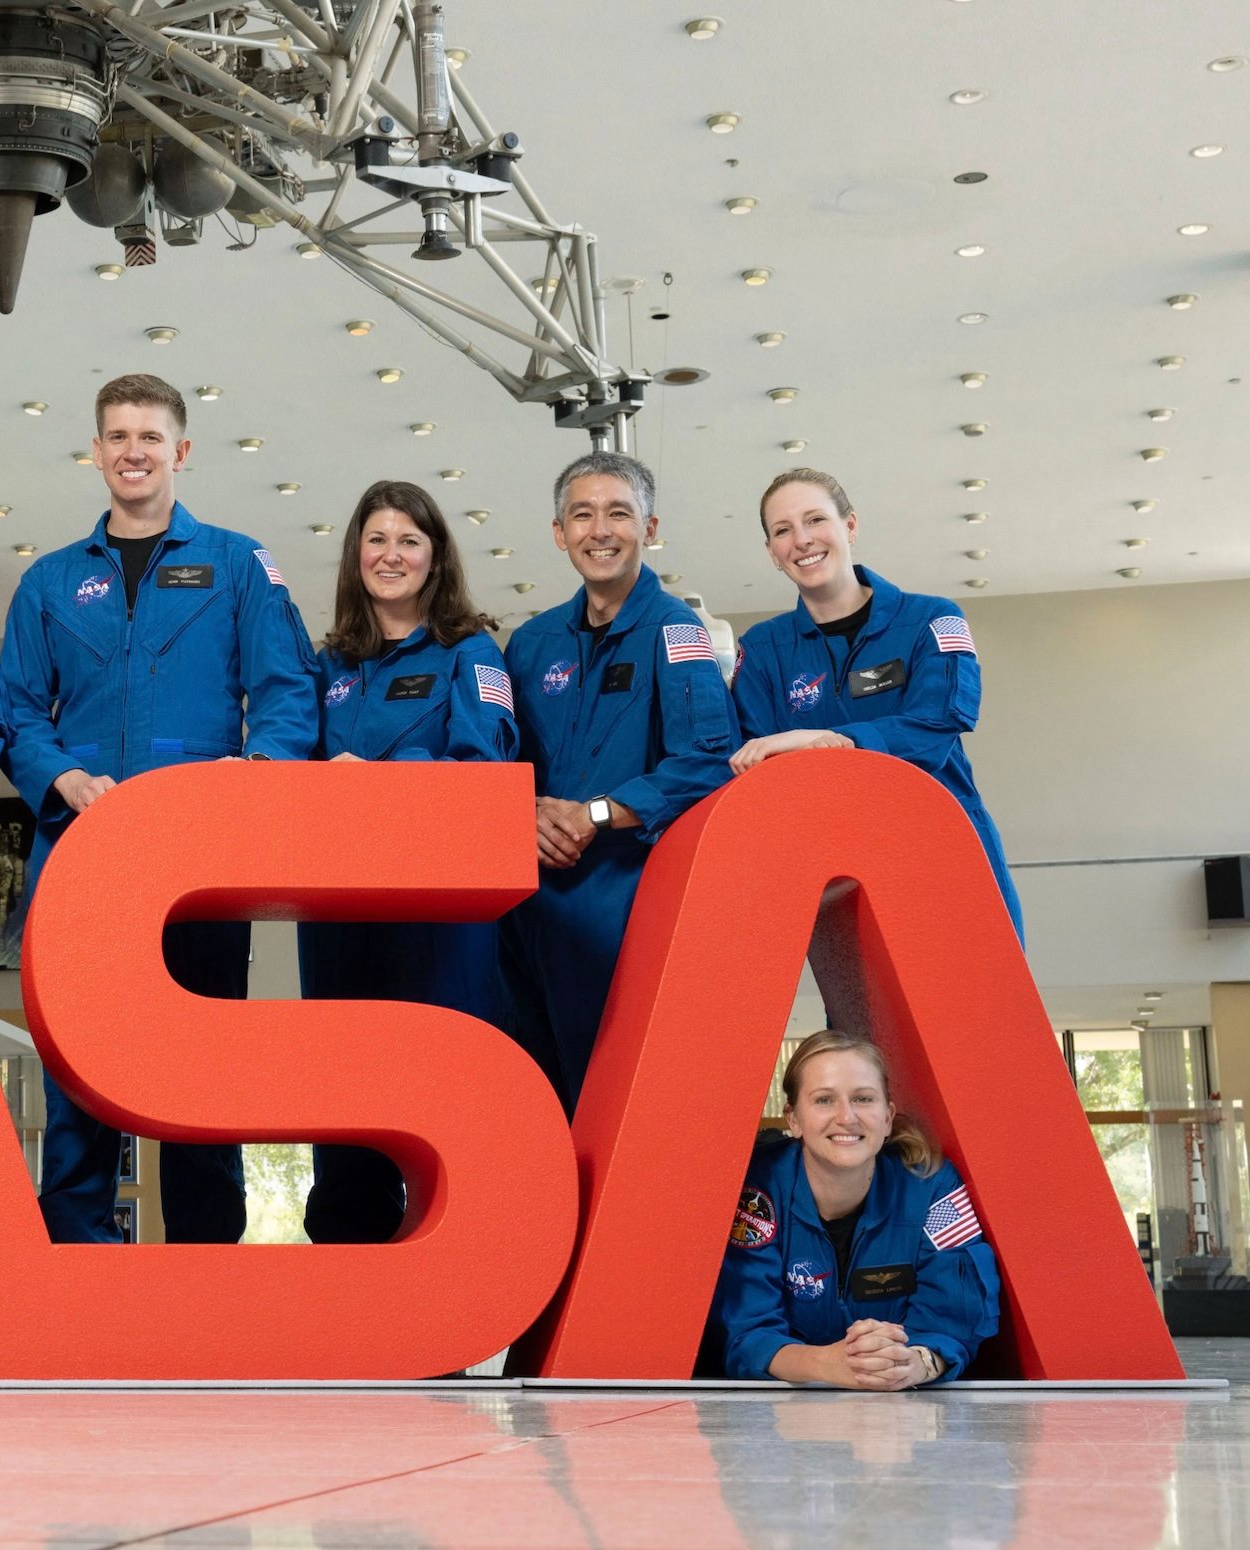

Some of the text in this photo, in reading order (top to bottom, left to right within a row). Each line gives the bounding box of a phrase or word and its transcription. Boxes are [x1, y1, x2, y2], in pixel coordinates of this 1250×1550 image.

[76, 582, 110, 596] NASA
[543, 672, 569, 682] NASA
[788, 686, 821, 700] NASA
[785, 1270, 824, 1291] NASA
